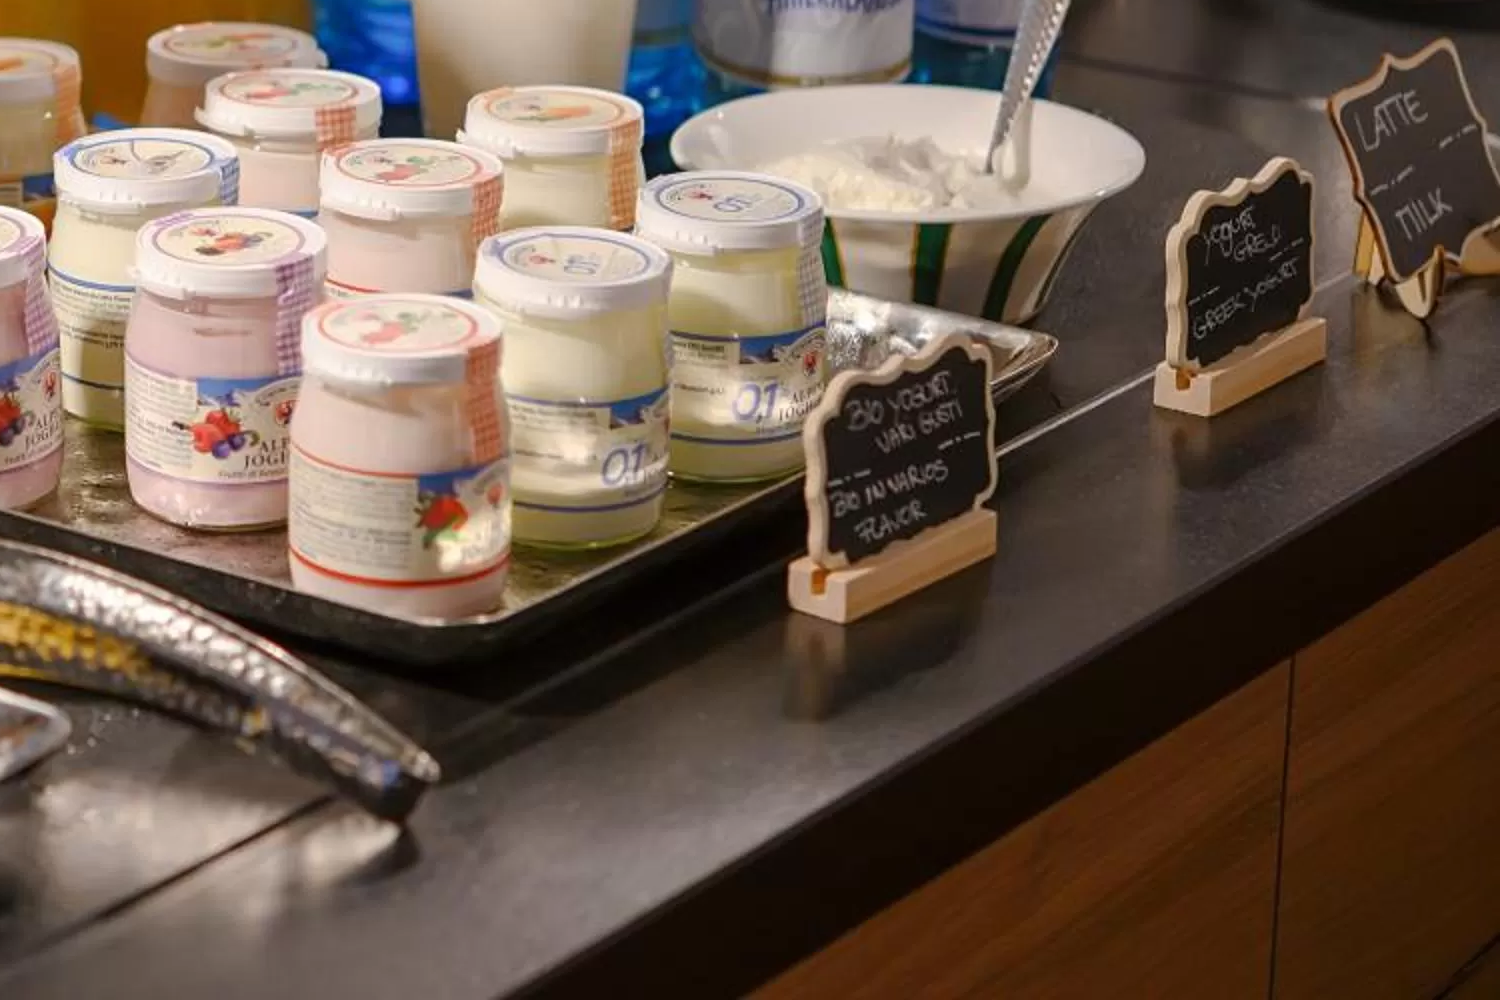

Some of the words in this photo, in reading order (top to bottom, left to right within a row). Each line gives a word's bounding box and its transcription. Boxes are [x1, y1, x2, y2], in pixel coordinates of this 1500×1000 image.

[1354, 89, 1429, 152] LATTE
[1395, 186, 1453, 241] MILK
[864, 479, 888, 506] IN
